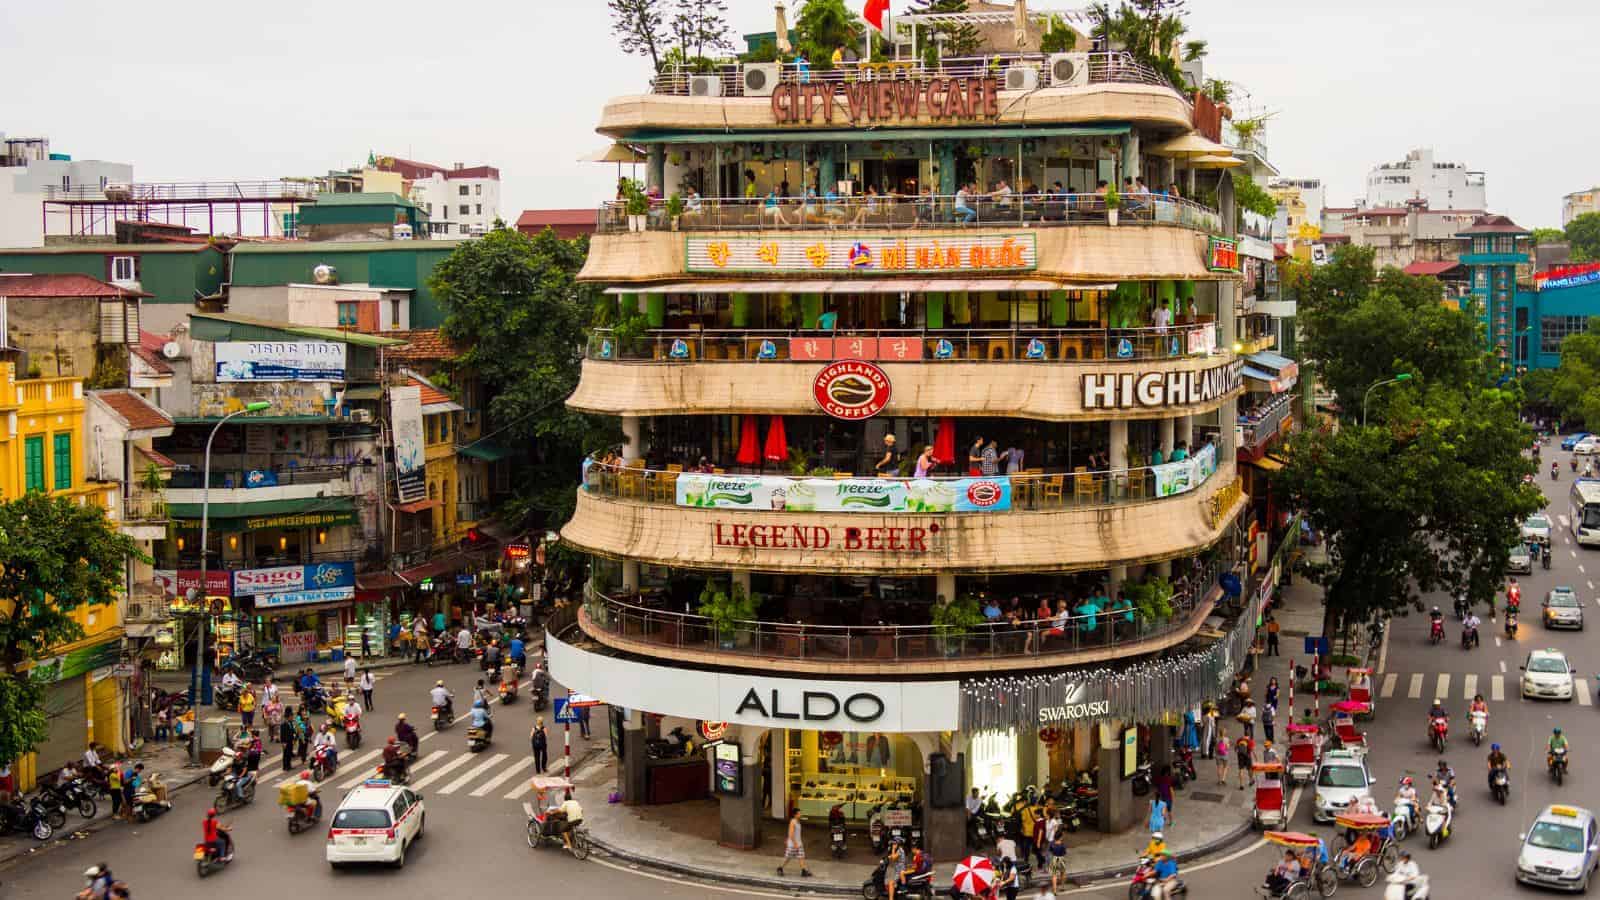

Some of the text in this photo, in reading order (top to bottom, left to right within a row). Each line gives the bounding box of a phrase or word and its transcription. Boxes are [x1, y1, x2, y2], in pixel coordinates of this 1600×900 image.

[771, 78, 998, 123] CITY VIEW CAFE
[817, 363, 886, 389] HIGHLANDS
[1085, 364, 1226, 408] HIGHLANDS
[826, 402, 879, 417] COFFEE
[707, 479, 746, 497] freeze
[837, 482, 883, 496] freeze
[716, 521, 927, 551] LEGEND BEER
[237, 569, 303, 586] Sago
[735, 687, 885, 723] ALDO
[1039, 701, 1109, 722] SWAROVSKI
